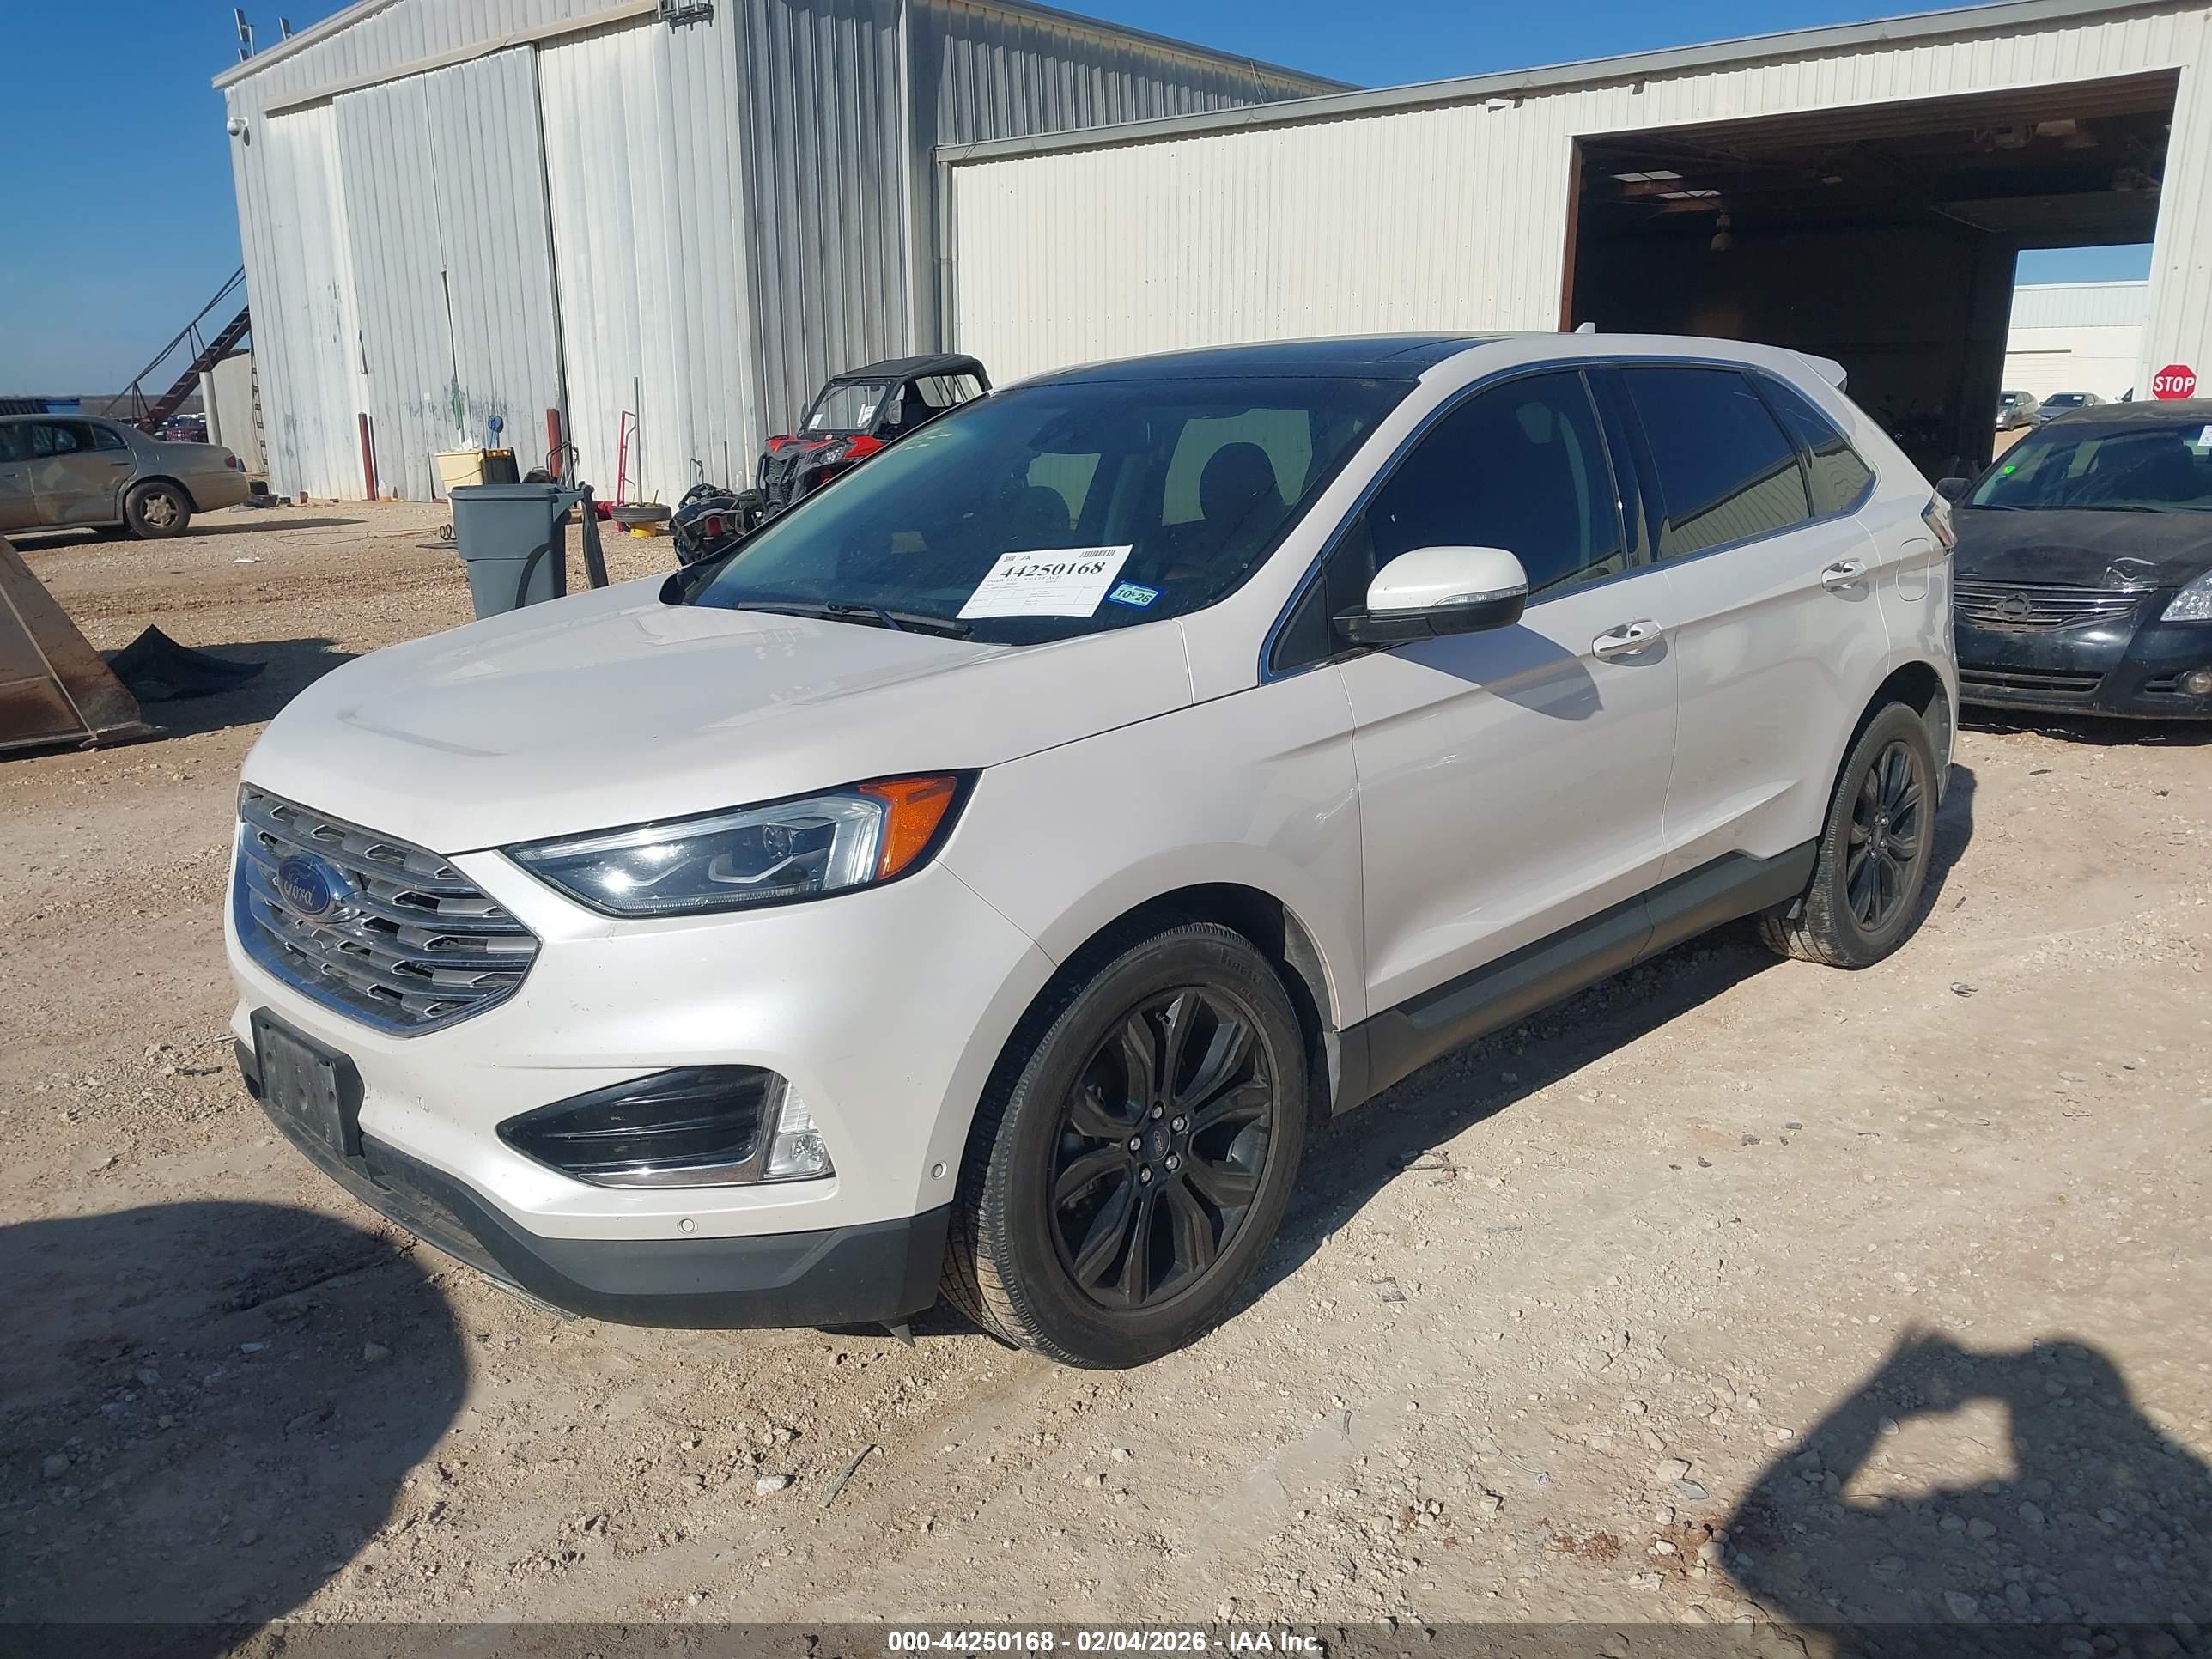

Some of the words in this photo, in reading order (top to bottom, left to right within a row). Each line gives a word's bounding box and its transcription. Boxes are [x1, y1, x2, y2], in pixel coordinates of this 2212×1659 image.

[2154, 376, 2195, 392] STOP
[1000, 561, 1106, 578] 44250168
[1134, 592, 1152, 603] 26
